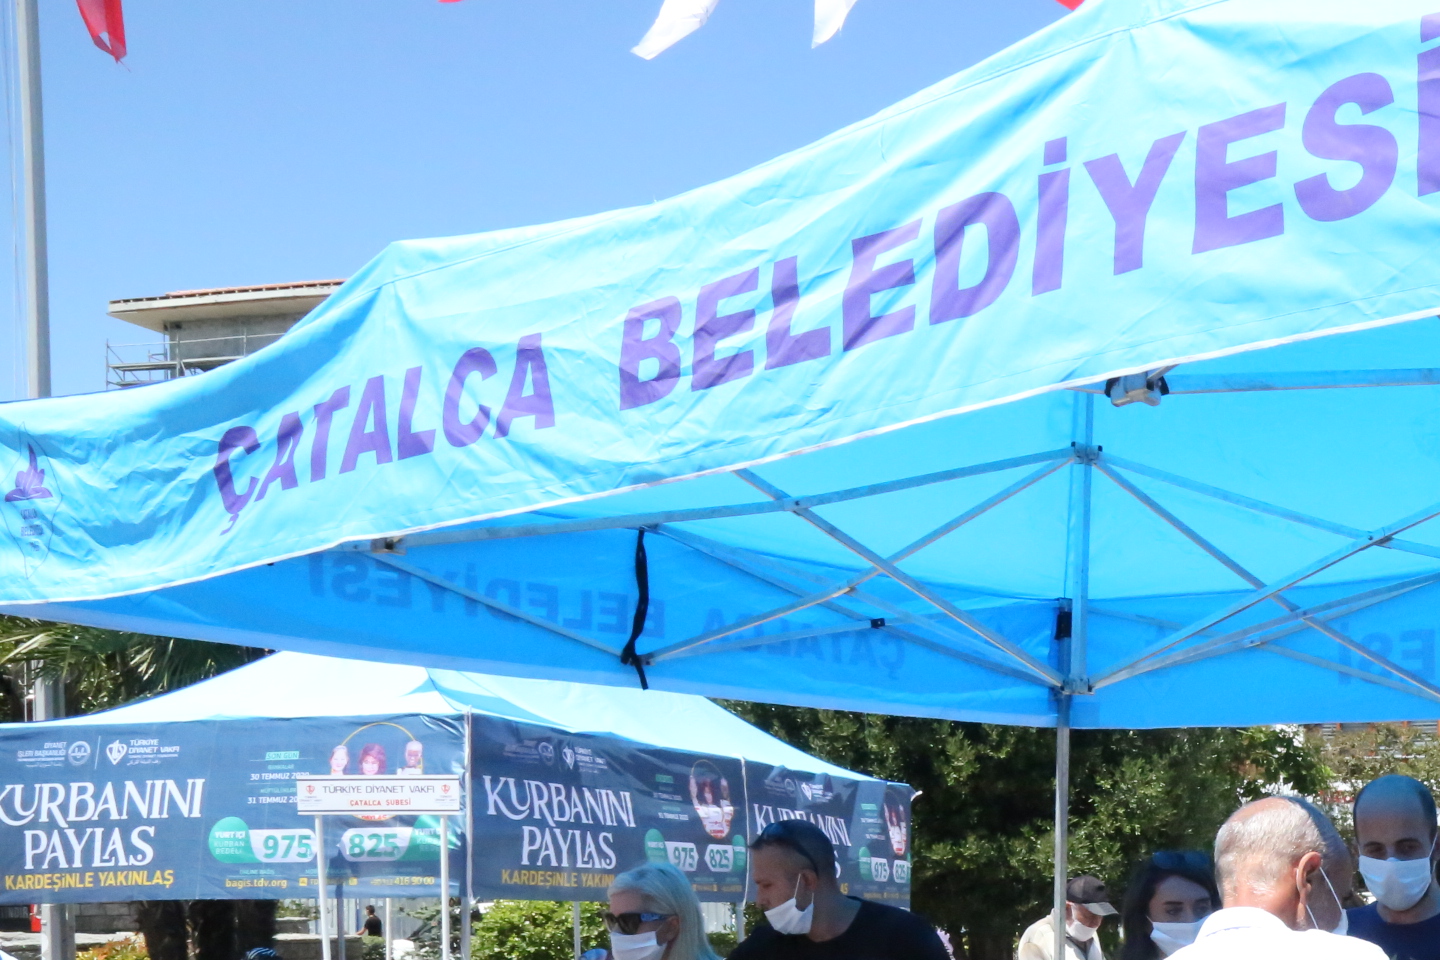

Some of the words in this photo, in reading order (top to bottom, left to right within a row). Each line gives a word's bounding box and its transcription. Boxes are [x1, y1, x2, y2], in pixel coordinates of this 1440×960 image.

[213, 333, 556, 536] ÇATALCA
[322, 783, 362, 793] TÜRKİYE
[365, 783, 406, 793] DİYANET
[409, 785, 435, 793] VAKFI
[259, 796, 288, 804] TEMMUZ
[482, 775, 637, 827] KURBANINI
[263, 834, 312, 859] 975
[349, 833, 398, 858] 825
[673, 846, 694, 868] 975
[709, 848, 730, 869] 825
[98, 870, 174, 888] YAKINLAŞ
[225, 878, 287, 889] bagis.tdv.org
